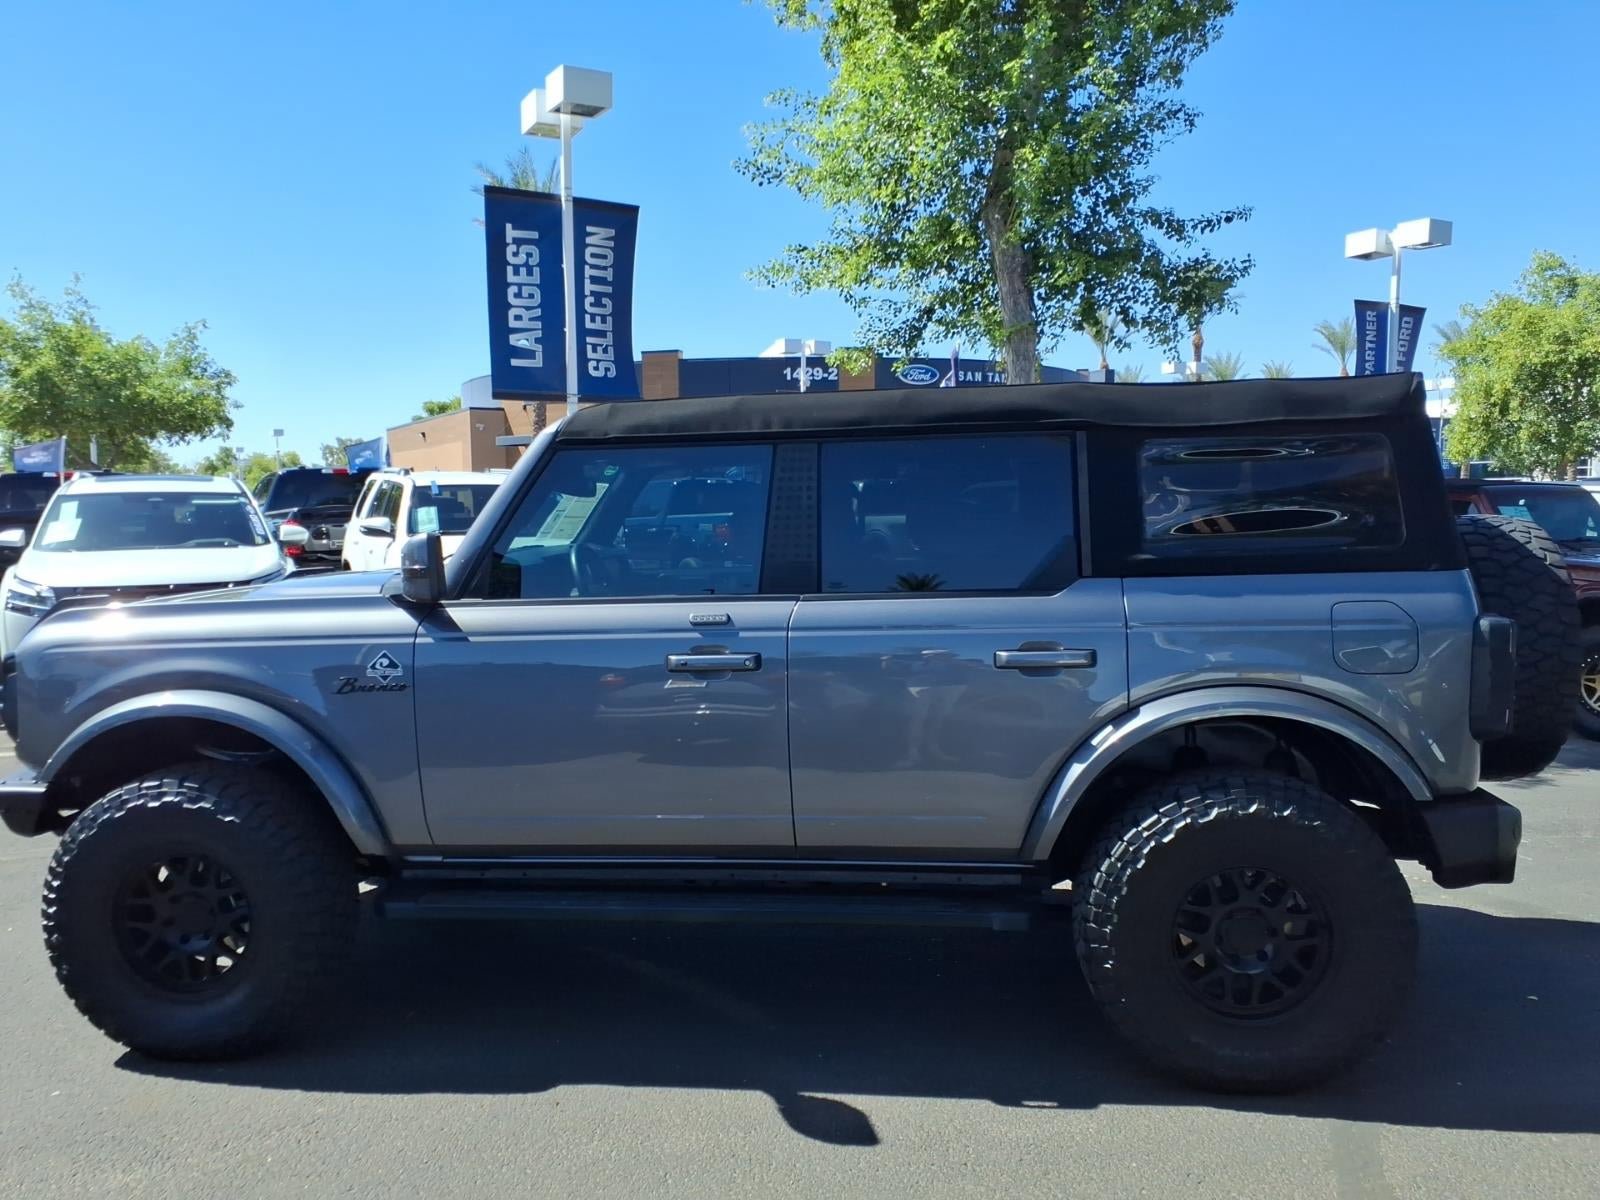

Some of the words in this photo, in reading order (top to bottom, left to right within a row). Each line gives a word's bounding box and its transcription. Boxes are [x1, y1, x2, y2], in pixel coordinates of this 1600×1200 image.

[505, 222, 543, 368] LARGEST
[584, 225, 616, 379] SELECTION
[1397, 316, 1414, 361] FORD
[958, 371, 982, 382] SAN
[335, 676, 409, 694] Bronco
